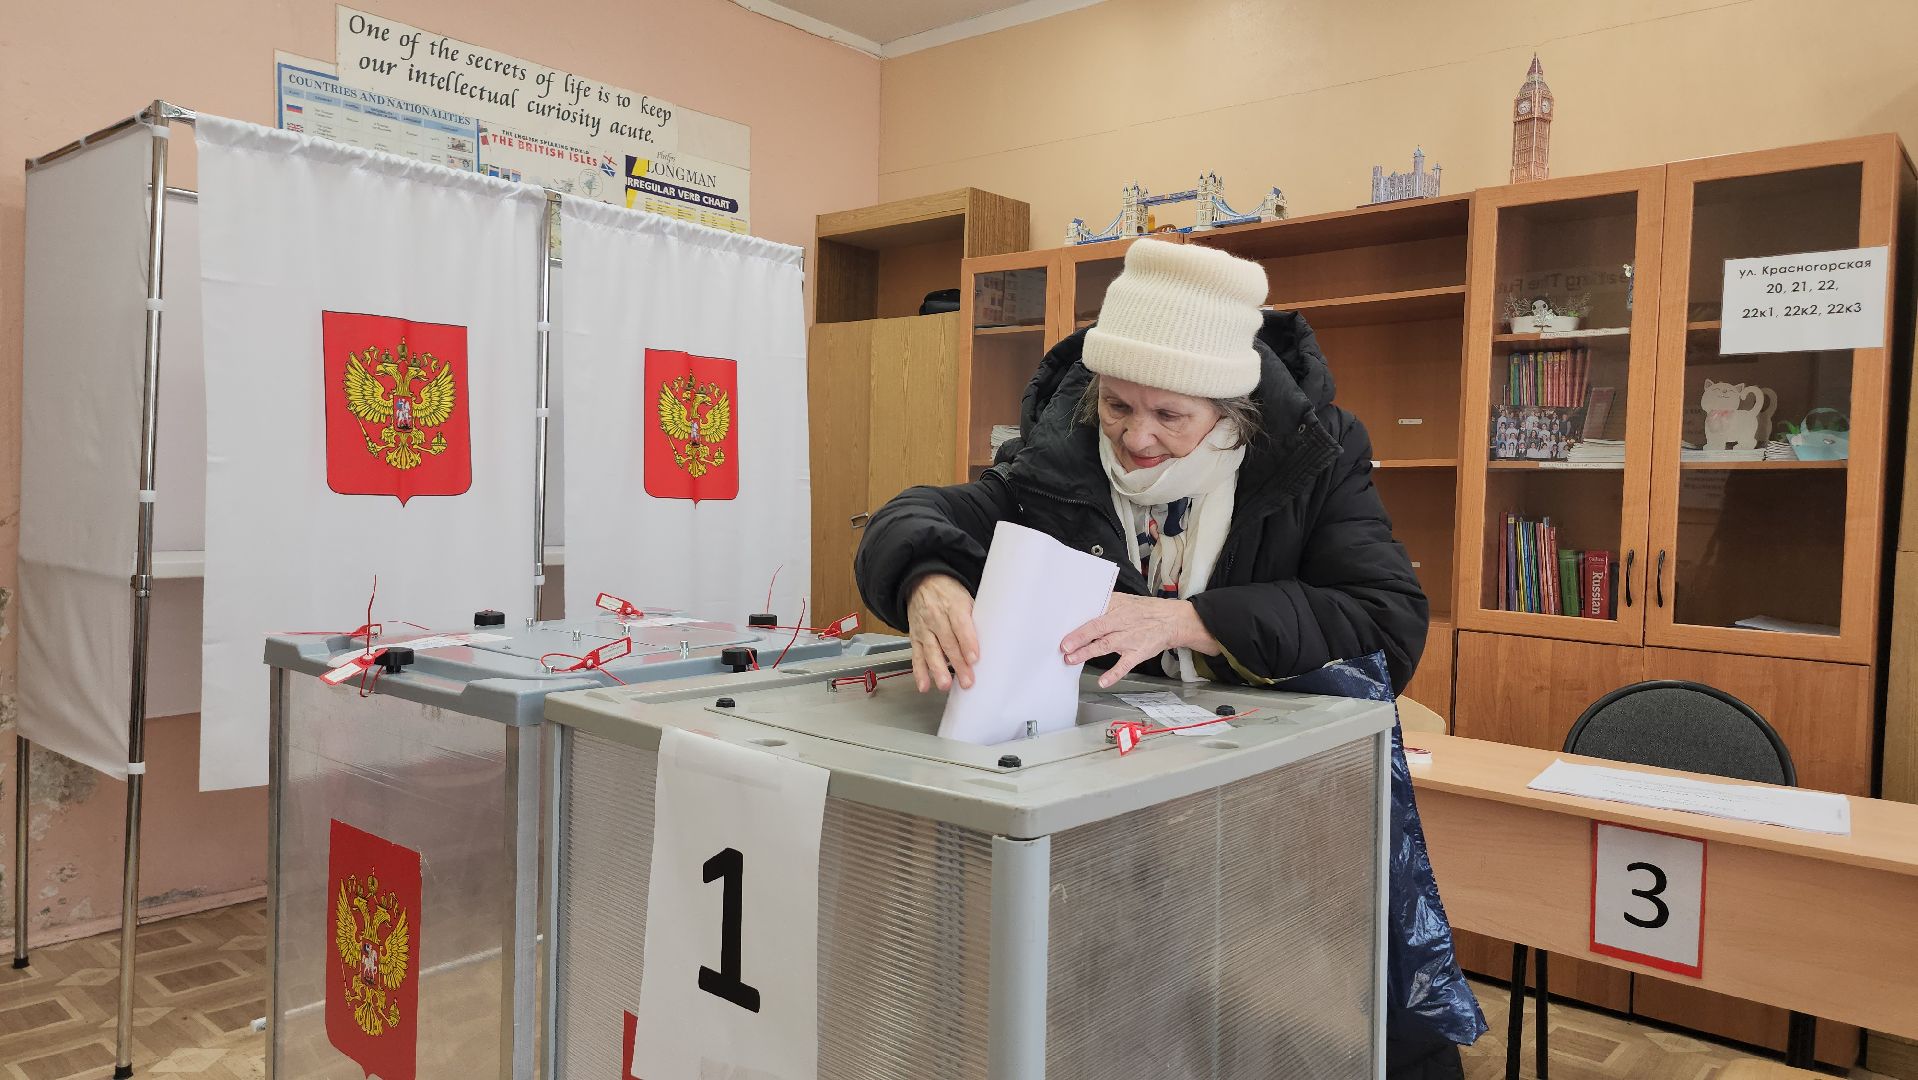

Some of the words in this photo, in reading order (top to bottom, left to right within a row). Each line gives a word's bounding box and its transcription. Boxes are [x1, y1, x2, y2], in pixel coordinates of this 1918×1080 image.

[349, 15, 390, 41] One
[400, 32, 421, 60] of
[430, 37, 459, 61] the
[466, 53, 527, 81] secrets
[536, 72, 555, 98] of
[564, 73, 591, 105] life
[598, 86, 609, 103] is
[616, 92, 631, 108] to
[641, 96, 672, 127] keep
[289, 73, 357, 98] COUNTRIES
[360, 91, 385, 105] AND
[387, 98, 471, 125] NATIONALITIES
[359, 56, 398, 76] our
[408, 63, 518, 109] intellectual
[527, 99, 601, 137] curiosity
[609, 120, 654, 144] acute.
[491, 133, 514, 147] THE
[518, 140, 564, 159] BRITISH
[569, 152, 598, 167] ISLES
[646, 159, 717, 188] LONGMAN
[677, 188, 701, 202] VERB
[702, 195, 731, 210] CHART
[1739, 269, 1757, 279] ул.
[1762, 259, 1871, 276] Красногорская
[1766, 283, 1787, 294] 20,
[1791, 281, 1812, 293] 21,
[1817, 279, 1839, 291] 22,
[1827, 302, 1862, 315] 22к3
[1591, 570, 1604, 615] Russian
[1623, 861, 1670, 929] 3
[698, 847, 760, 1013] 1
